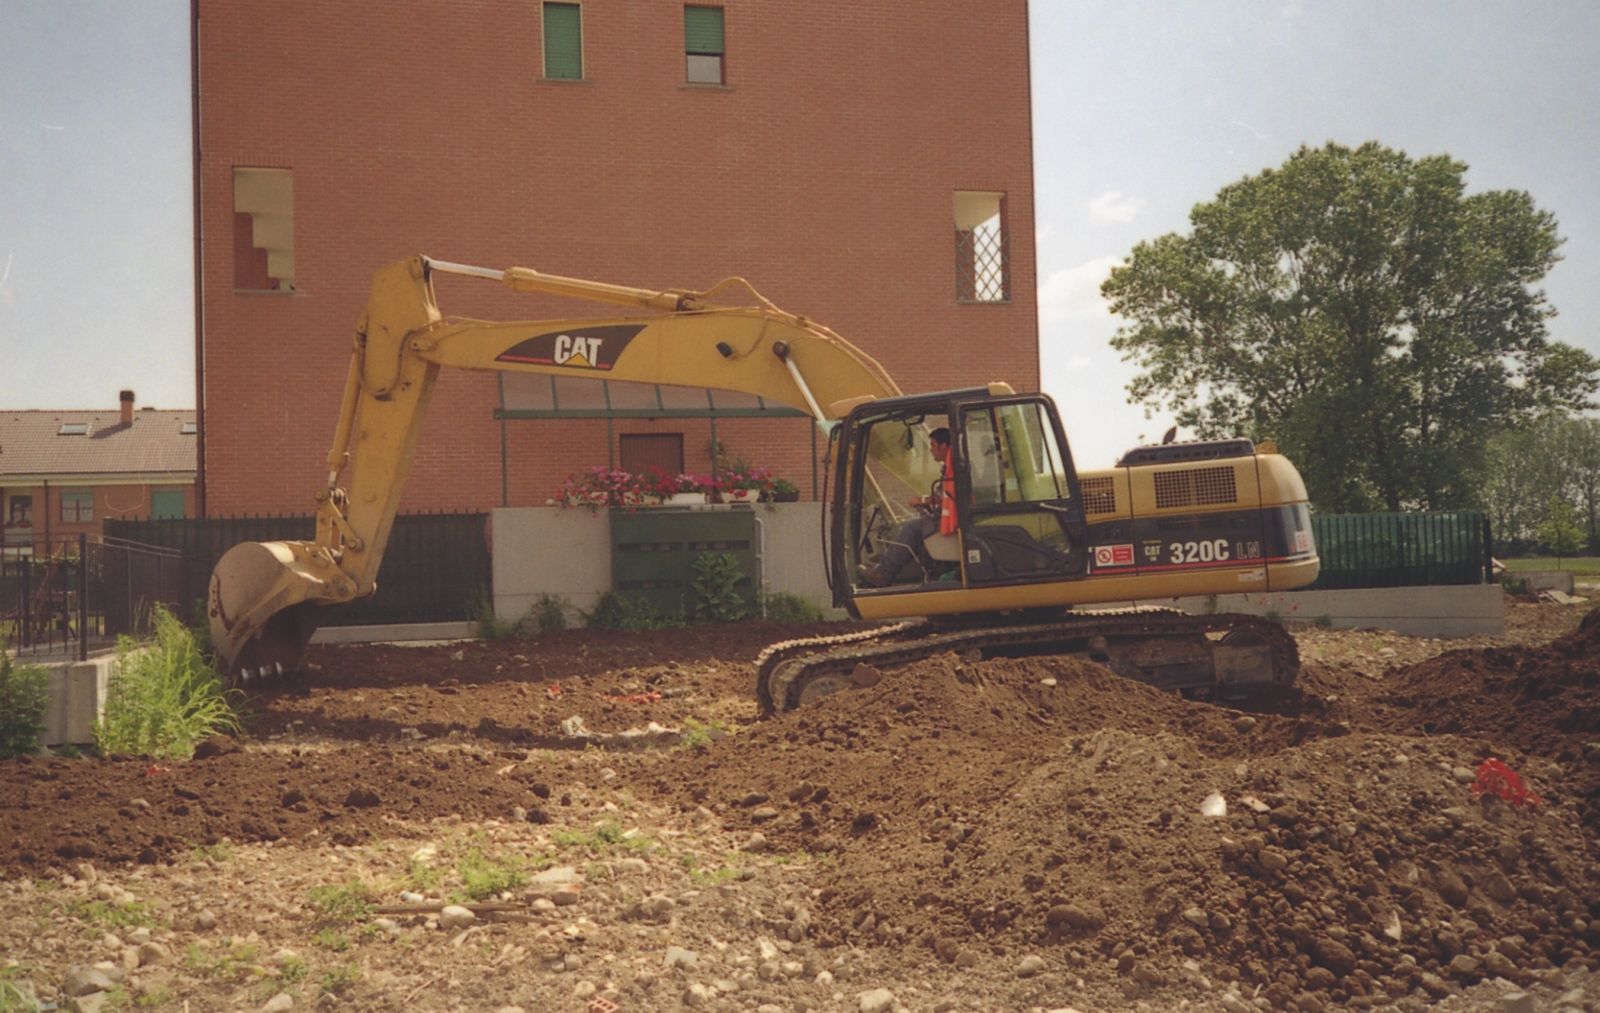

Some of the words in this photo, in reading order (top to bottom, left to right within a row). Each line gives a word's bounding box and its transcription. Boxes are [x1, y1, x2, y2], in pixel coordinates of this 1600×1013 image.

[554, 334, 604, 367] CAT
[1144, 545, 1161, 556] CAT
[1169, 539, 1229, 564] 320C
[1237, 541, 1260, 560] LN
